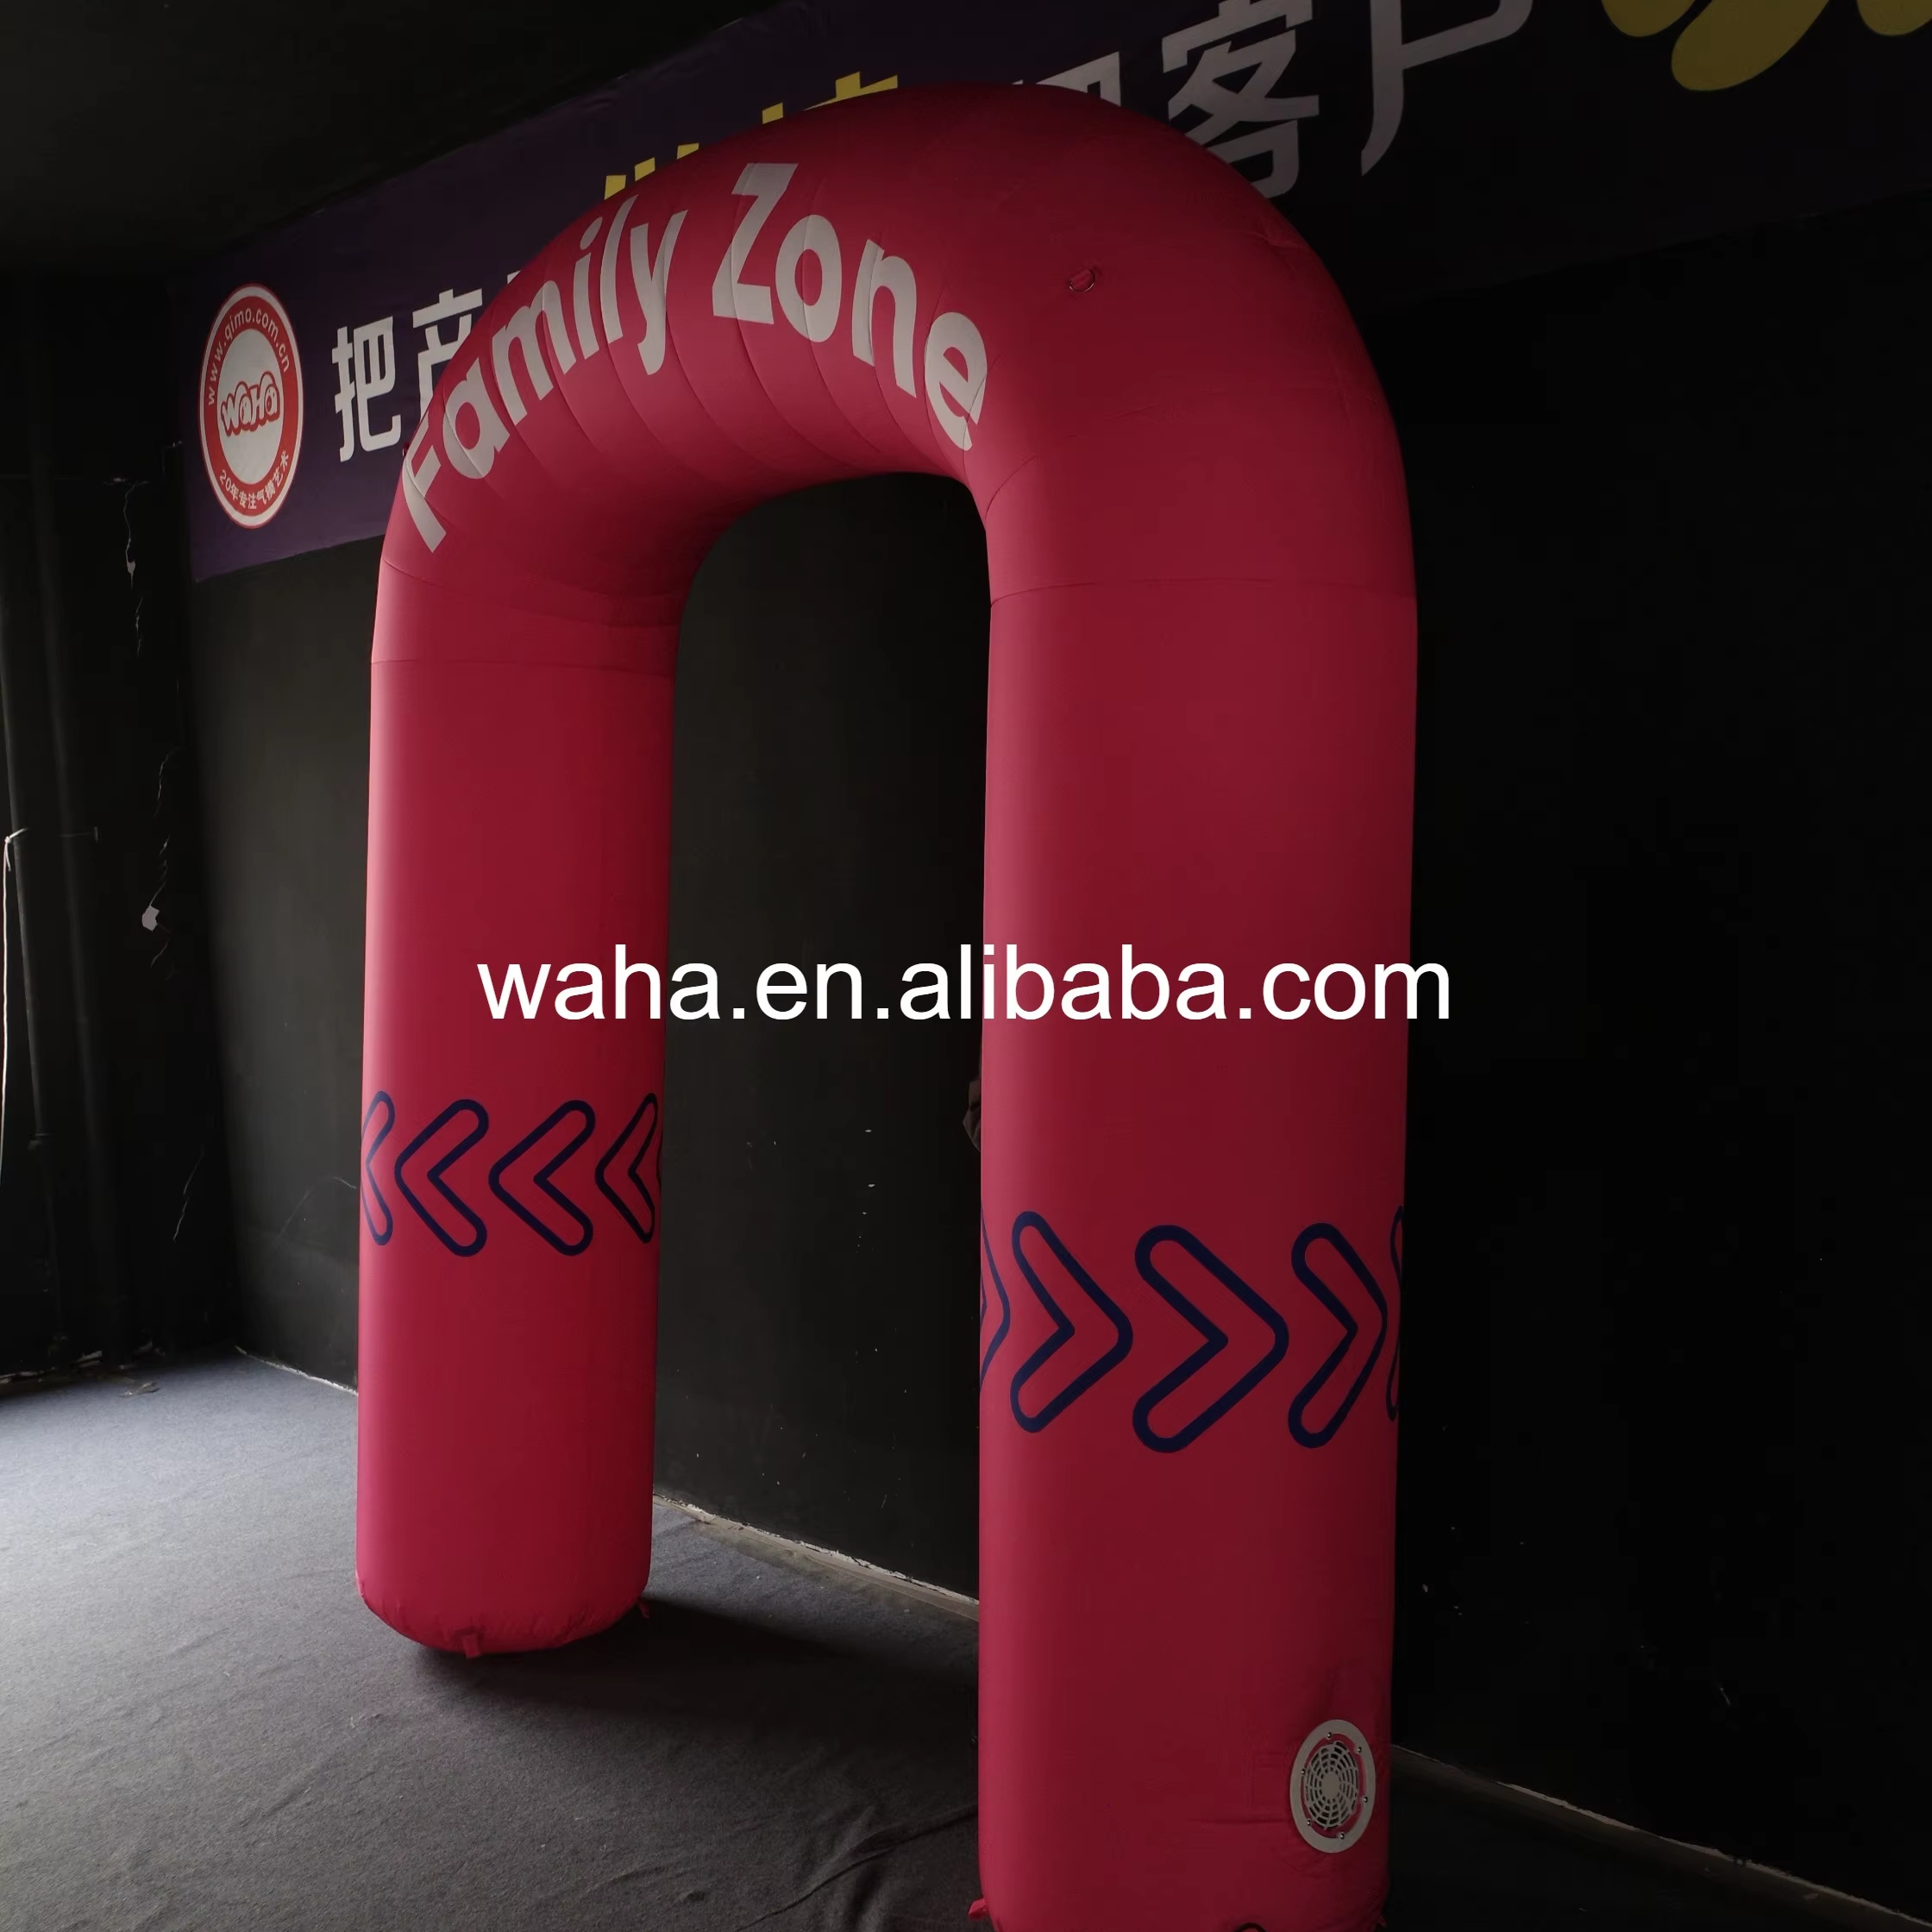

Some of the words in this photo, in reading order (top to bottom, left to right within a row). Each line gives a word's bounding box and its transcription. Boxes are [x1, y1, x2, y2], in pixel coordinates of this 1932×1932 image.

[1035, 0, 1534, 199] 客户
[208, 307, 291, 406] www.qimo.com.cn
[332, 271, 521, 462] 把产
[402, 194, 689, 553] Family
[712, 162, 988, 451] Zone
